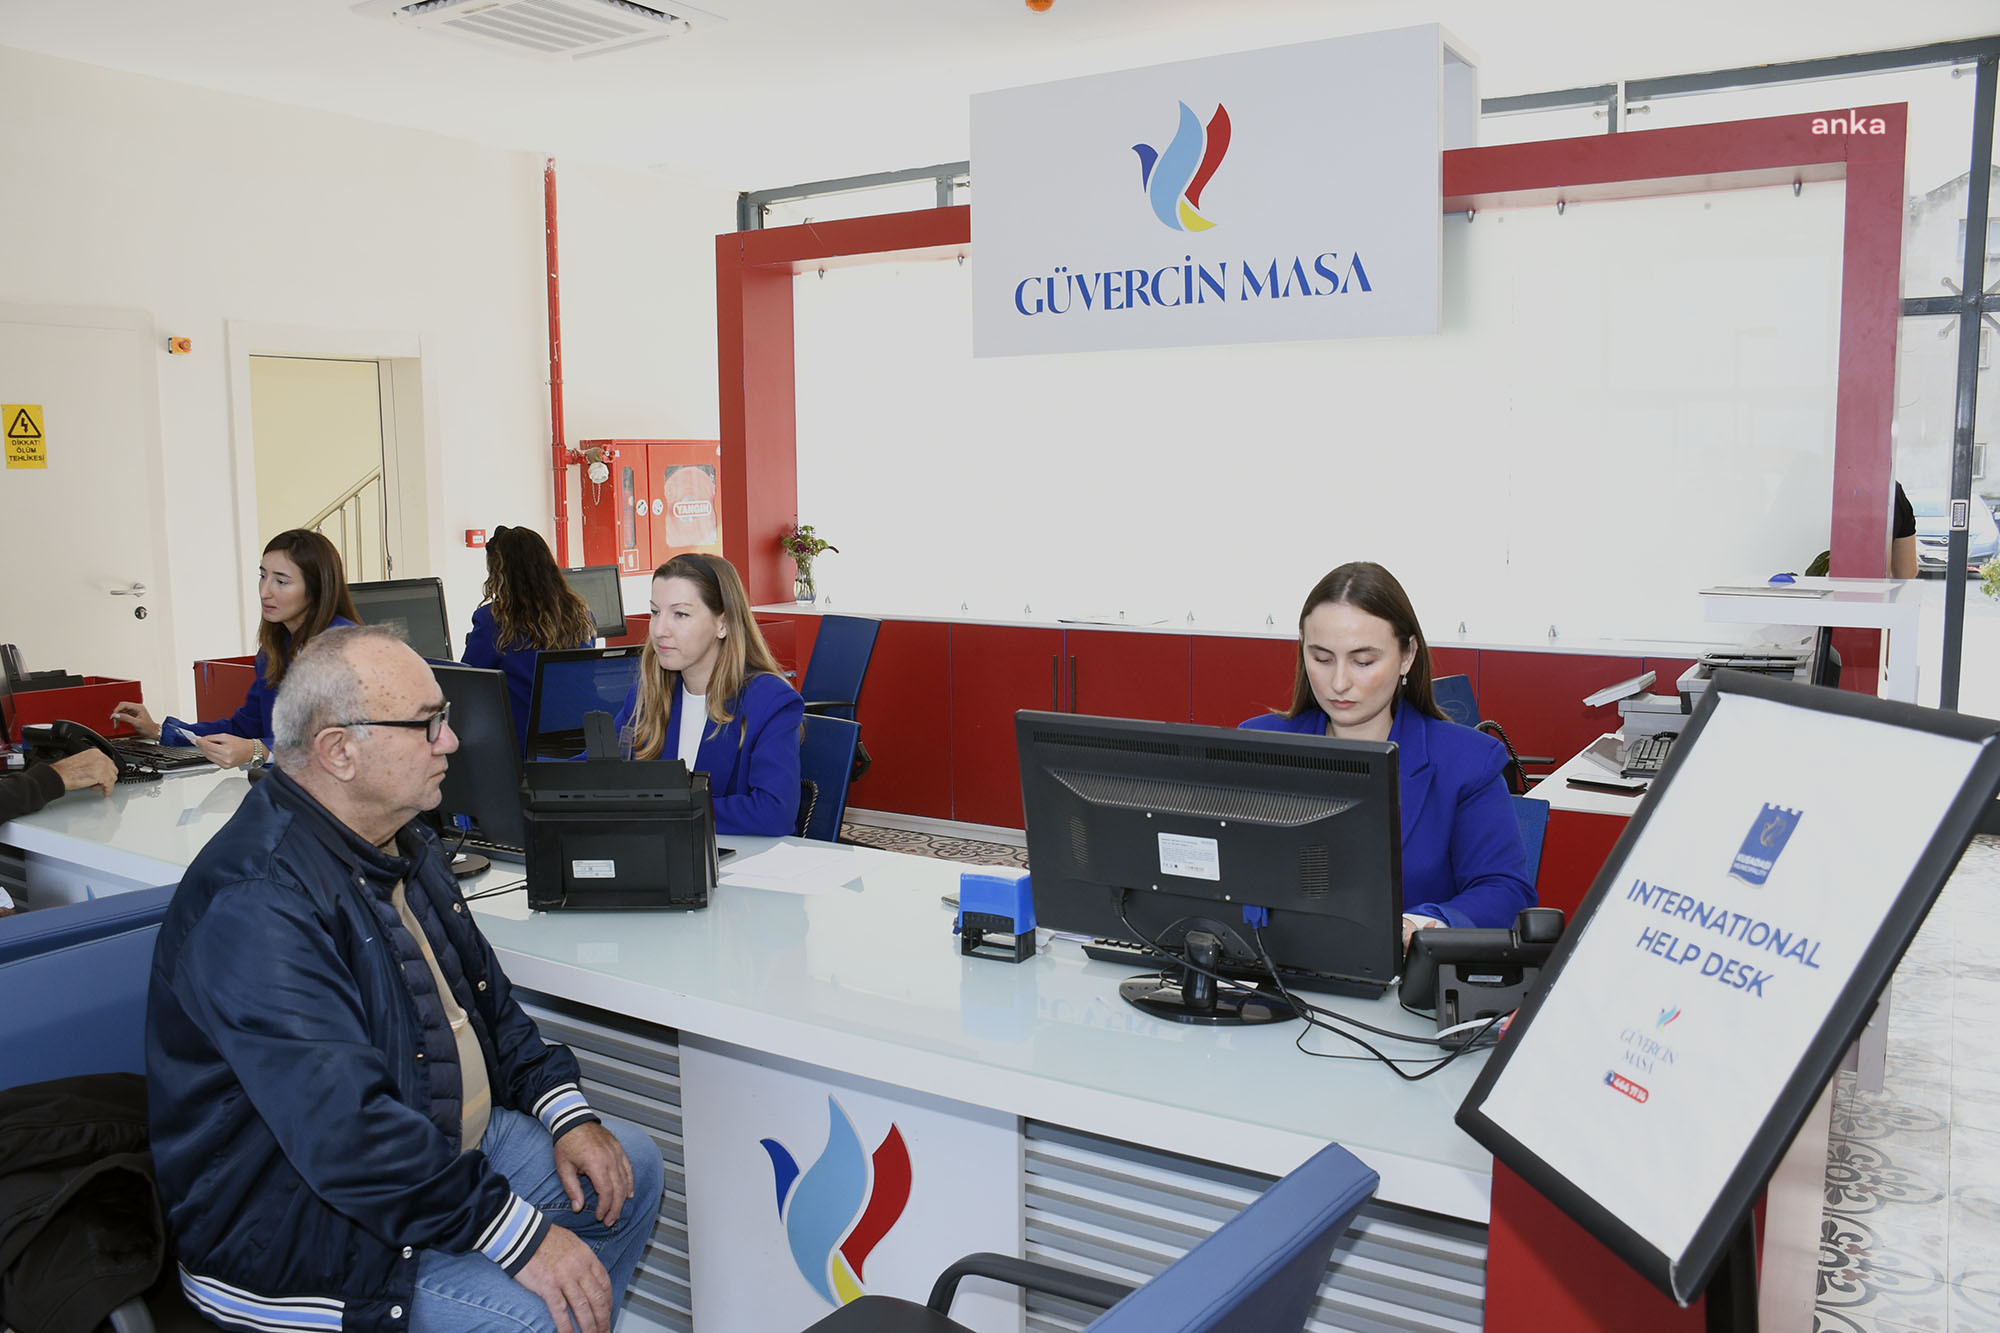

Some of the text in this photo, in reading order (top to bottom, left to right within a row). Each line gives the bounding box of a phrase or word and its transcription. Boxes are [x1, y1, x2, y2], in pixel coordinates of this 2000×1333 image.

[1015, 251, 1373, 316] GÜVERCİN MASA
[1626, 879, 1821, 969] INTERNATIONAL
[1635, 926, 1775, 998] HELP DESK
